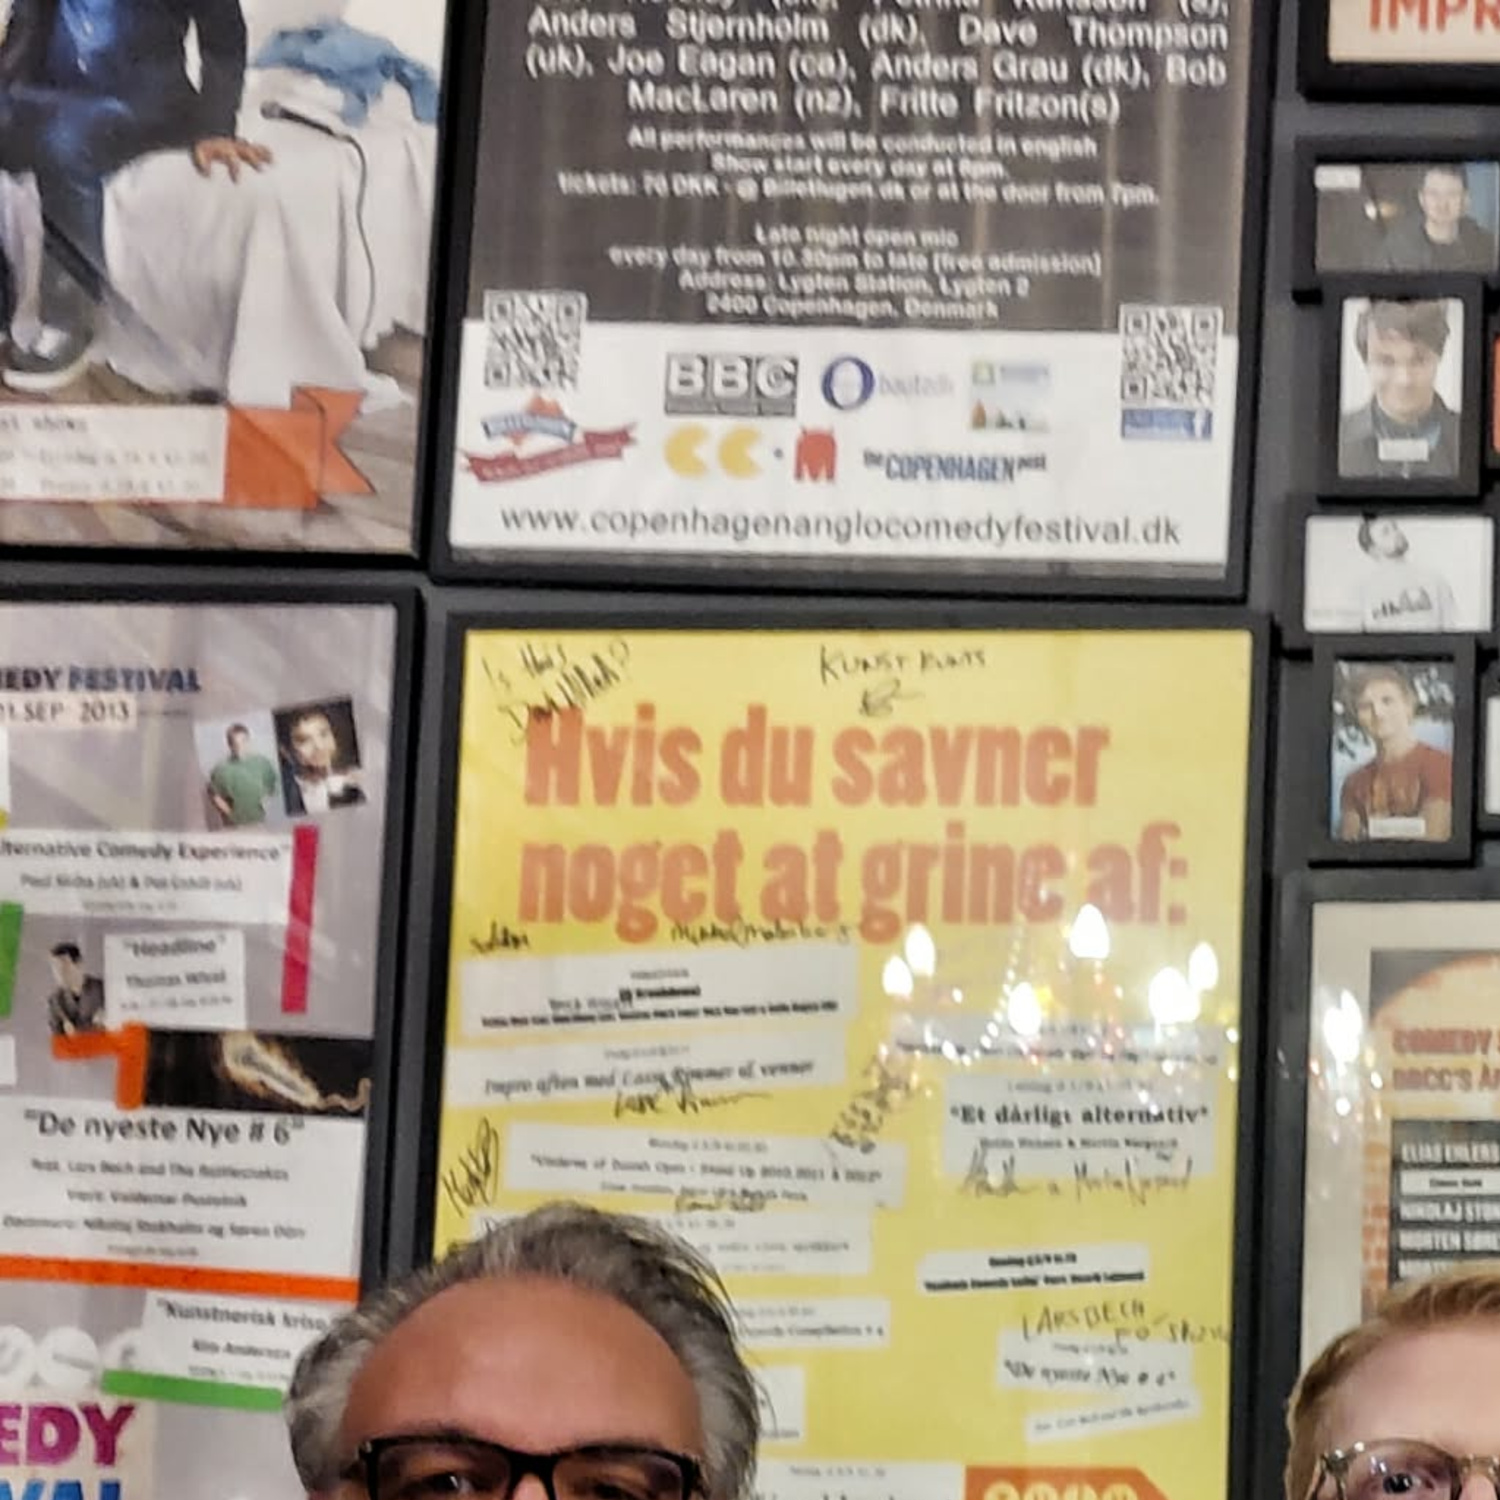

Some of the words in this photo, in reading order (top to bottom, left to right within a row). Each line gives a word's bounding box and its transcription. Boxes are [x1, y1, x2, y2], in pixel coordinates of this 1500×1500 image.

[528, 7, 637, 39] Anders
[958, 14, 1038, 46] Dave
[1066, 16, 1228, 54] Thompson
[607, 44, 665, 75] Joe
[872, 51, 978, 81] Anders
[1166, 54, 1227, 85] Bob
[667, 353, 798, 402] BBC
[886, 454, 1015, 483] COPENHAGEN
[0, 667, 61, 692] EDY
[69, 666, 202, 692] FESTIVAL
[523, 700, 704, 809] Hvis
[719, 702, 815, 809] du
[832, 726, 1111, 810] savner
[96, 842, 172, 861] Comedy
[518, 828, 744, 944] noget
[758, 828, 840, 924] at
[860, 821, 1068, 945] grine
[1085, 820, 1189, 925] af:
[85, 1115, 180, 1144] nyeste
[186, 1117, 241, 1149] Nye
[0, 1402, 136, 1468] EDY
